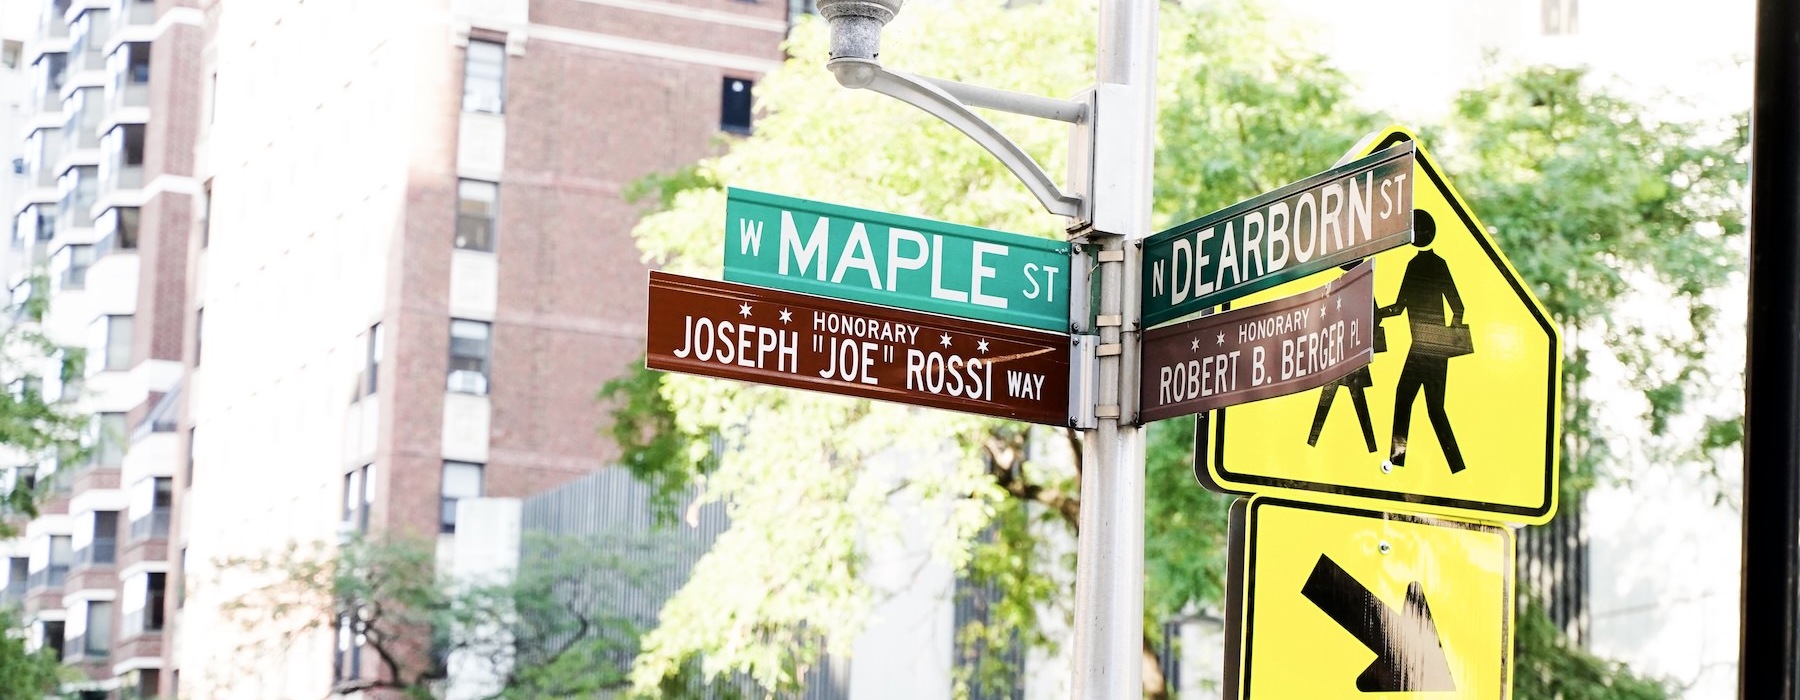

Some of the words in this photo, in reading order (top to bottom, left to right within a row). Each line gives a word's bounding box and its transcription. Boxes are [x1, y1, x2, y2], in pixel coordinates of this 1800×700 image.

[740, 218, 764, 256] W
[778, 210, 1009, 309] MAPLE
[1022, 263, 1059, 302] ST
[1152, 259, 1164, 297] N
[1171, 171, 1373, 305] DEARBORN
[1380, 174, 1406, 220] ST
[673, 316, 798, 373] JOSEPH
[812, 335, 894, 385] "JOE"
[907, 349, 992, 401] ROSSI
[1007, 370, 1045, 400] WAY
[813, 312, 920, 345] HONORARY
[1160, 350, 1240, 405] ROBERT
[1252, 346, 1272, 387] B.
[1281, 320, 1344, 381] BERGER
[1350, 319, 1361, 348] PL
[1239, 308, 1310, 344] HONORARY
